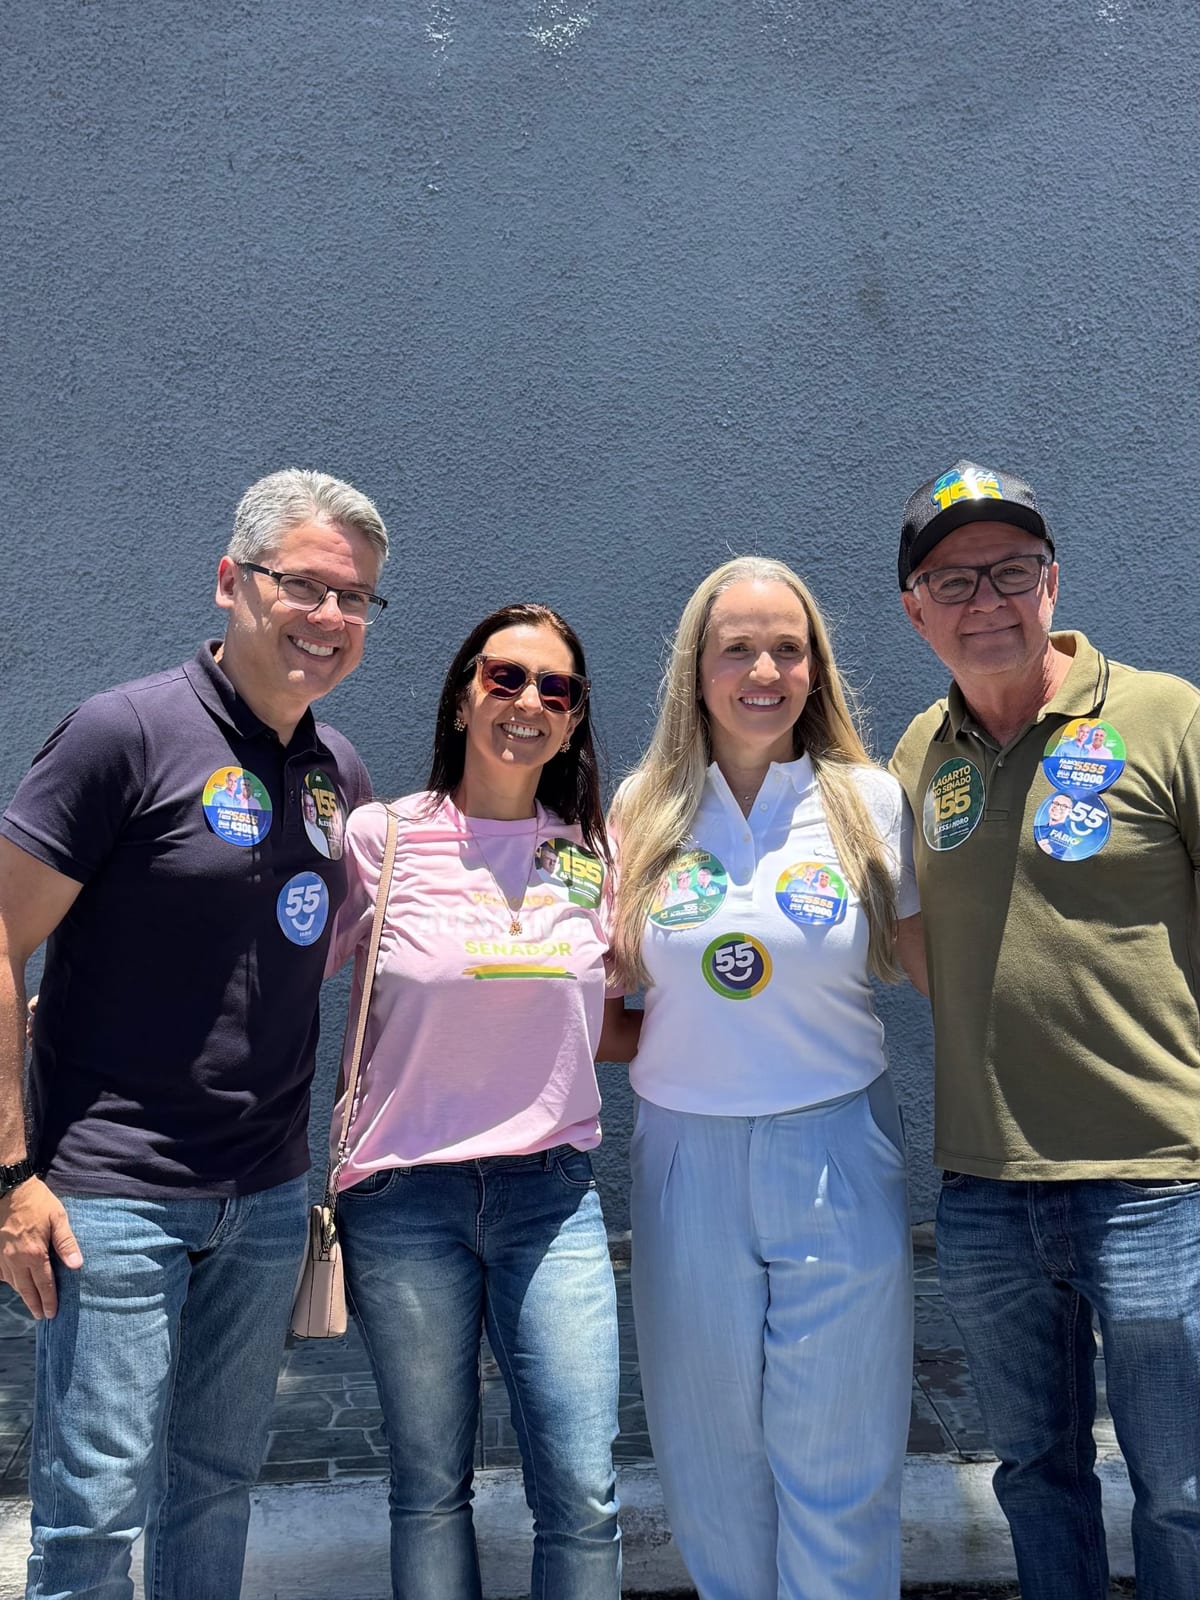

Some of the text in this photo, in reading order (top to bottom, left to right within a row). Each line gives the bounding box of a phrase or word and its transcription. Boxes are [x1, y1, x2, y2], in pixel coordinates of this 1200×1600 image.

[933, 480, 1003, 510] 155
[932, 765, 971, 790] LAGARTO
[942, 775, 971, 793] SENADO
[1071, 771, 1104, 785] 43000
[312, 788, 338, 817] 155
[934, 785, 972, 823] 155
[1069, 801, 1108, 828] 55
[558, 851, 602, 884] 155
[285, 884, 322, 916] 55
[465, 940, 572, 956] SENADOR
[715, 941, 755, 972] 55
